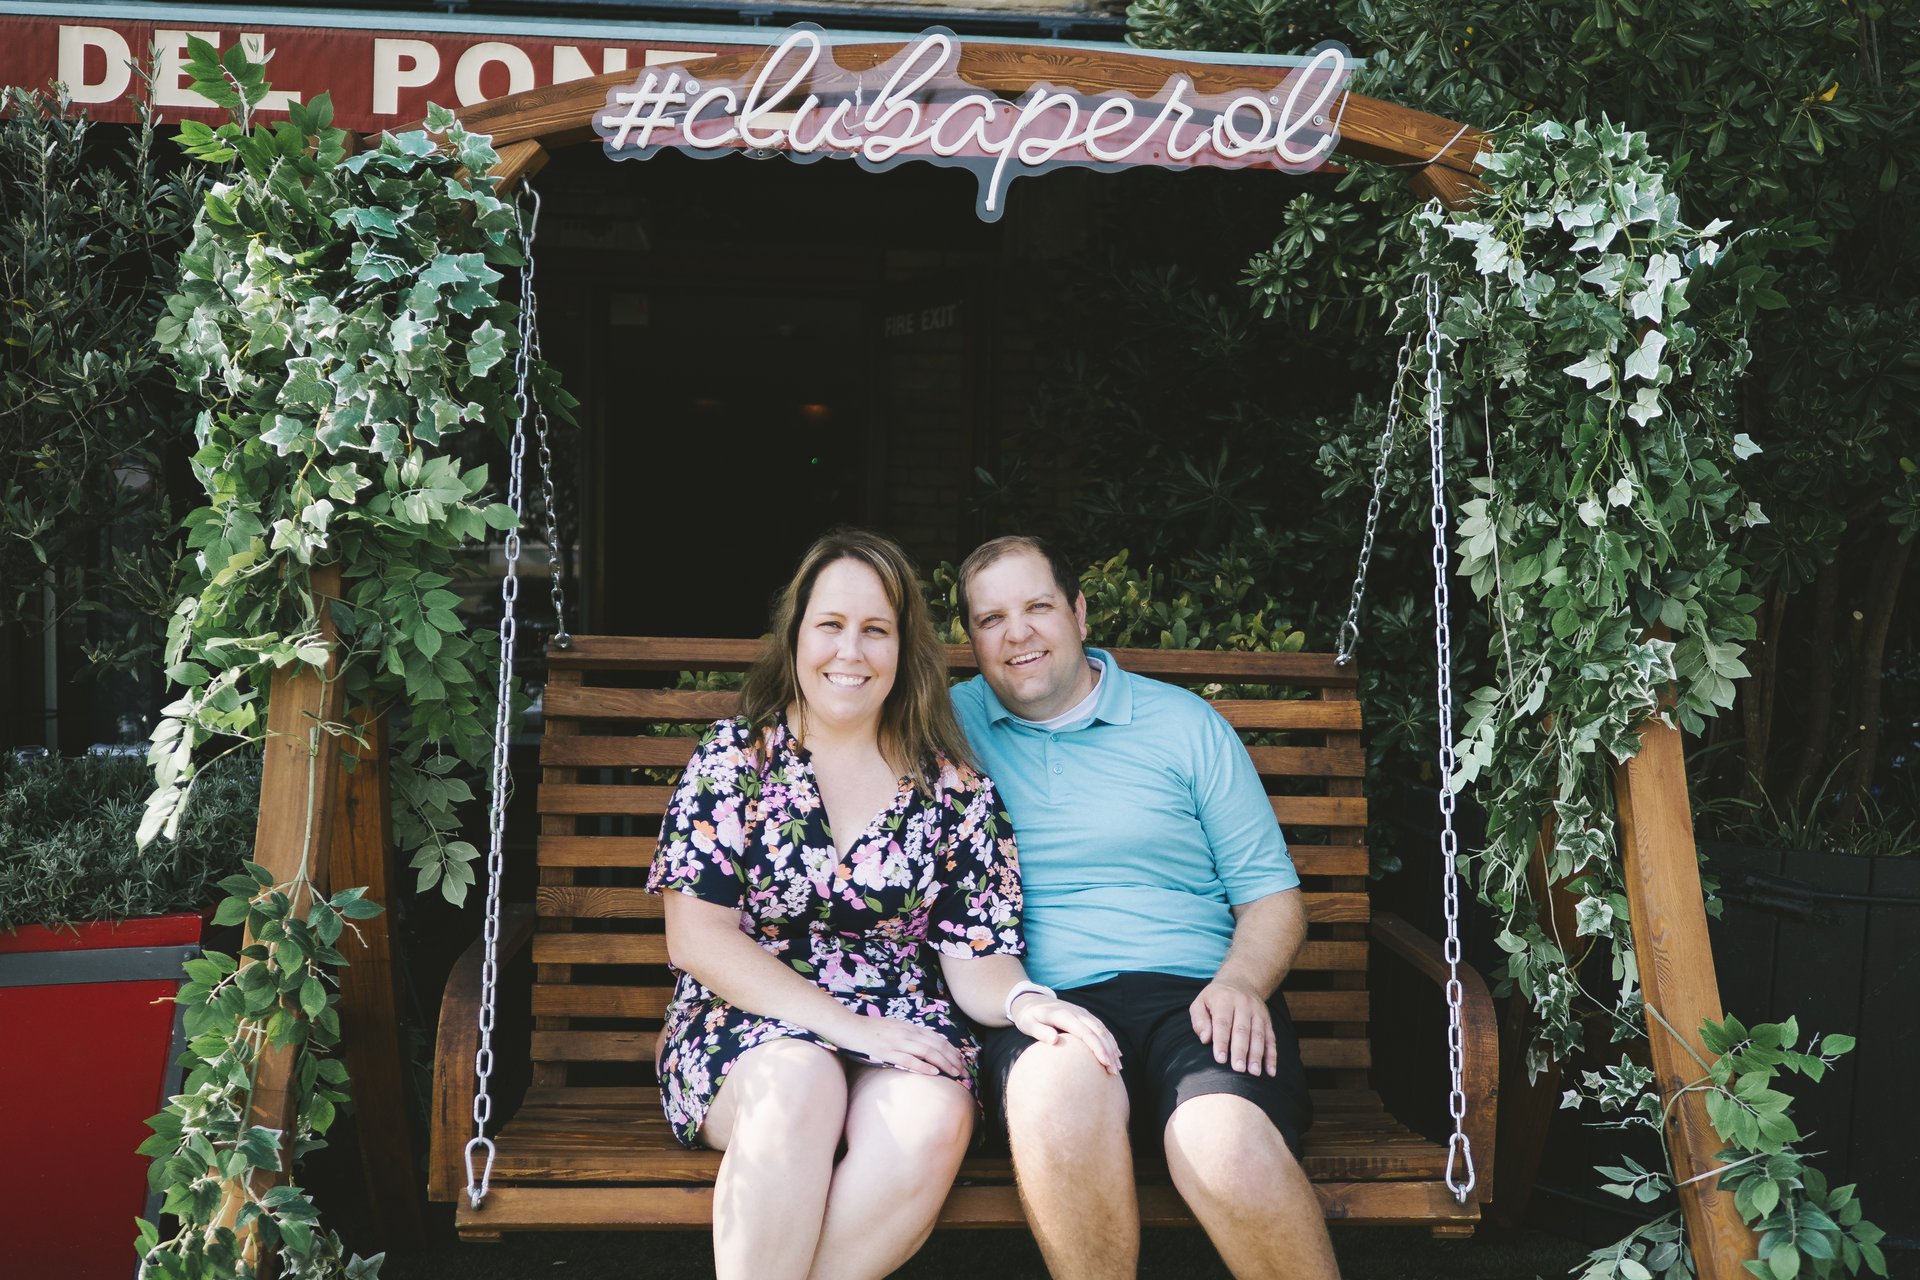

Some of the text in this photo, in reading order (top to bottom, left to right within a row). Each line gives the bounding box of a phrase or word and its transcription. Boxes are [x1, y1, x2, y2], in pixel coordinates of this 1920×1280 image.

[602, 30, 1344, 211] #clubaperol
[884, 303, 956, 338] FIRE EXIT
